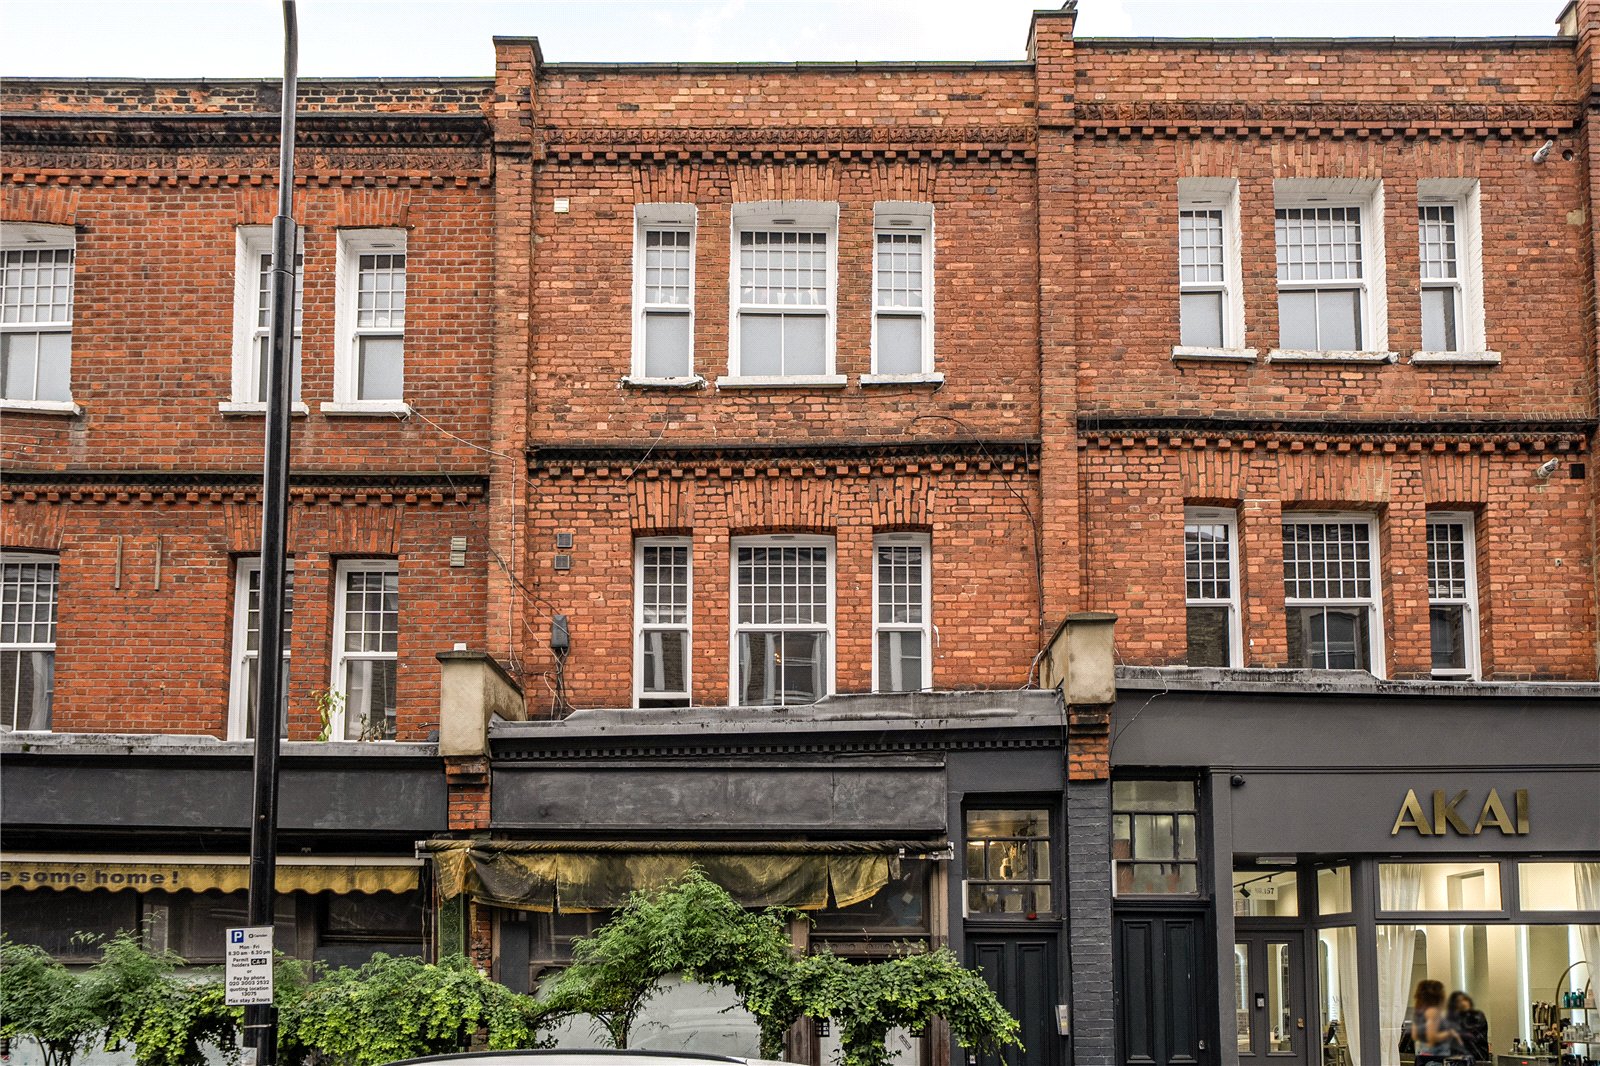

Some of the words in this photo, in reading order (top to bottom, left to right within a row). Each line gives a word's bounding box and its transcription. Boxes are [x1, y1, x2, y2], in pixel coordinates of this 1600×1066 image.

[1391, 788, 1529, 835] AKAI
[19, 871, 87, 883] some
[95, 869, 165, 884] home
[234, 931, 243, 943] P
